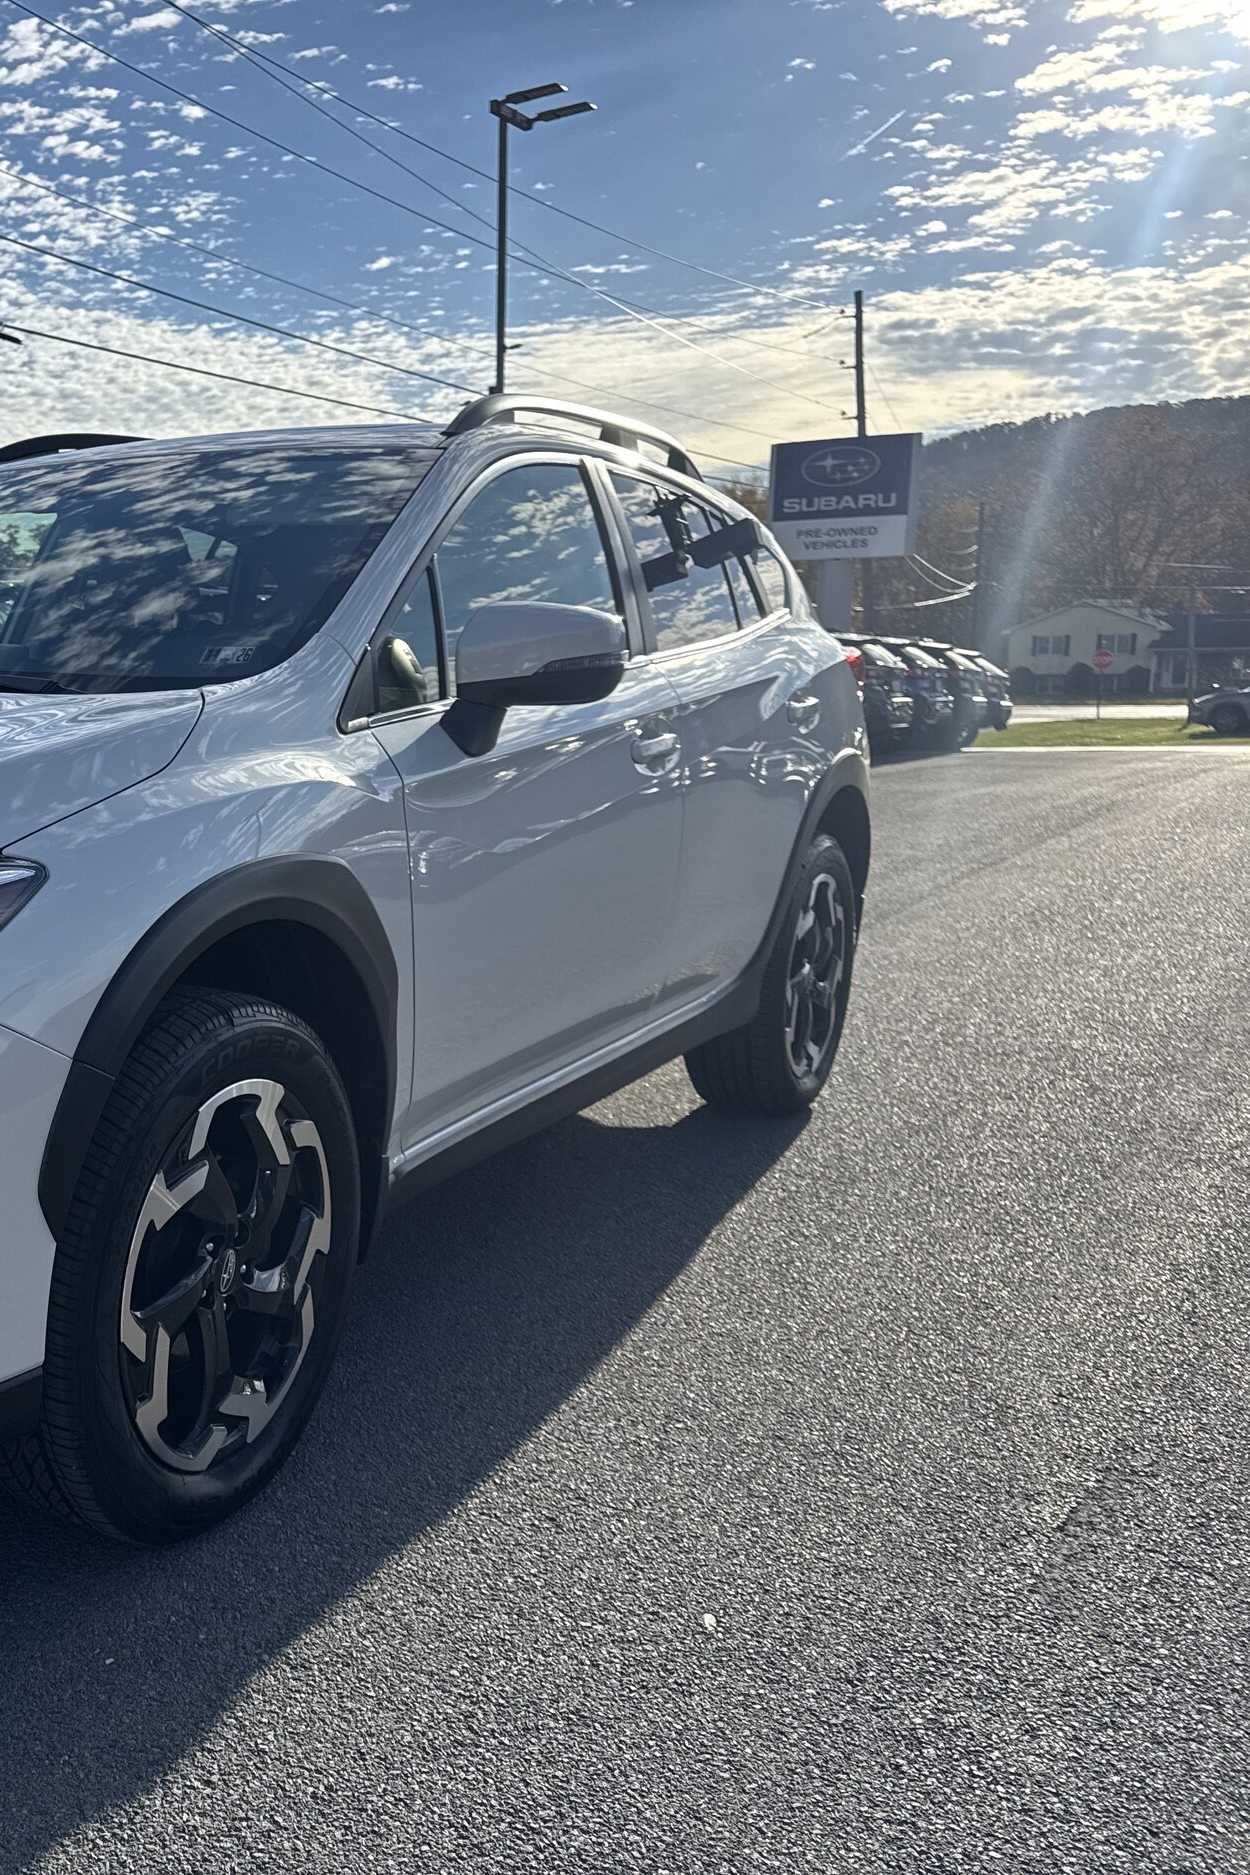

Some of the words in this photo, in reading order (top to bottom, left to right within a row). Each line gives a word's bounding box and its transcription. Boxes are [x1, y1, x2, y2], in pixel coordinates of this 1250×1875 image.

[782, 492, 897, 513] SUBARU
[796, 525, 878, 539] PRE-OWNED
[802, 538, 869, 550] VEHICLES
[236, 648, 253, 662] 26
[1093, 655, 1114, 665] STOP
[201, 1034, 301, 1087] COOPER
